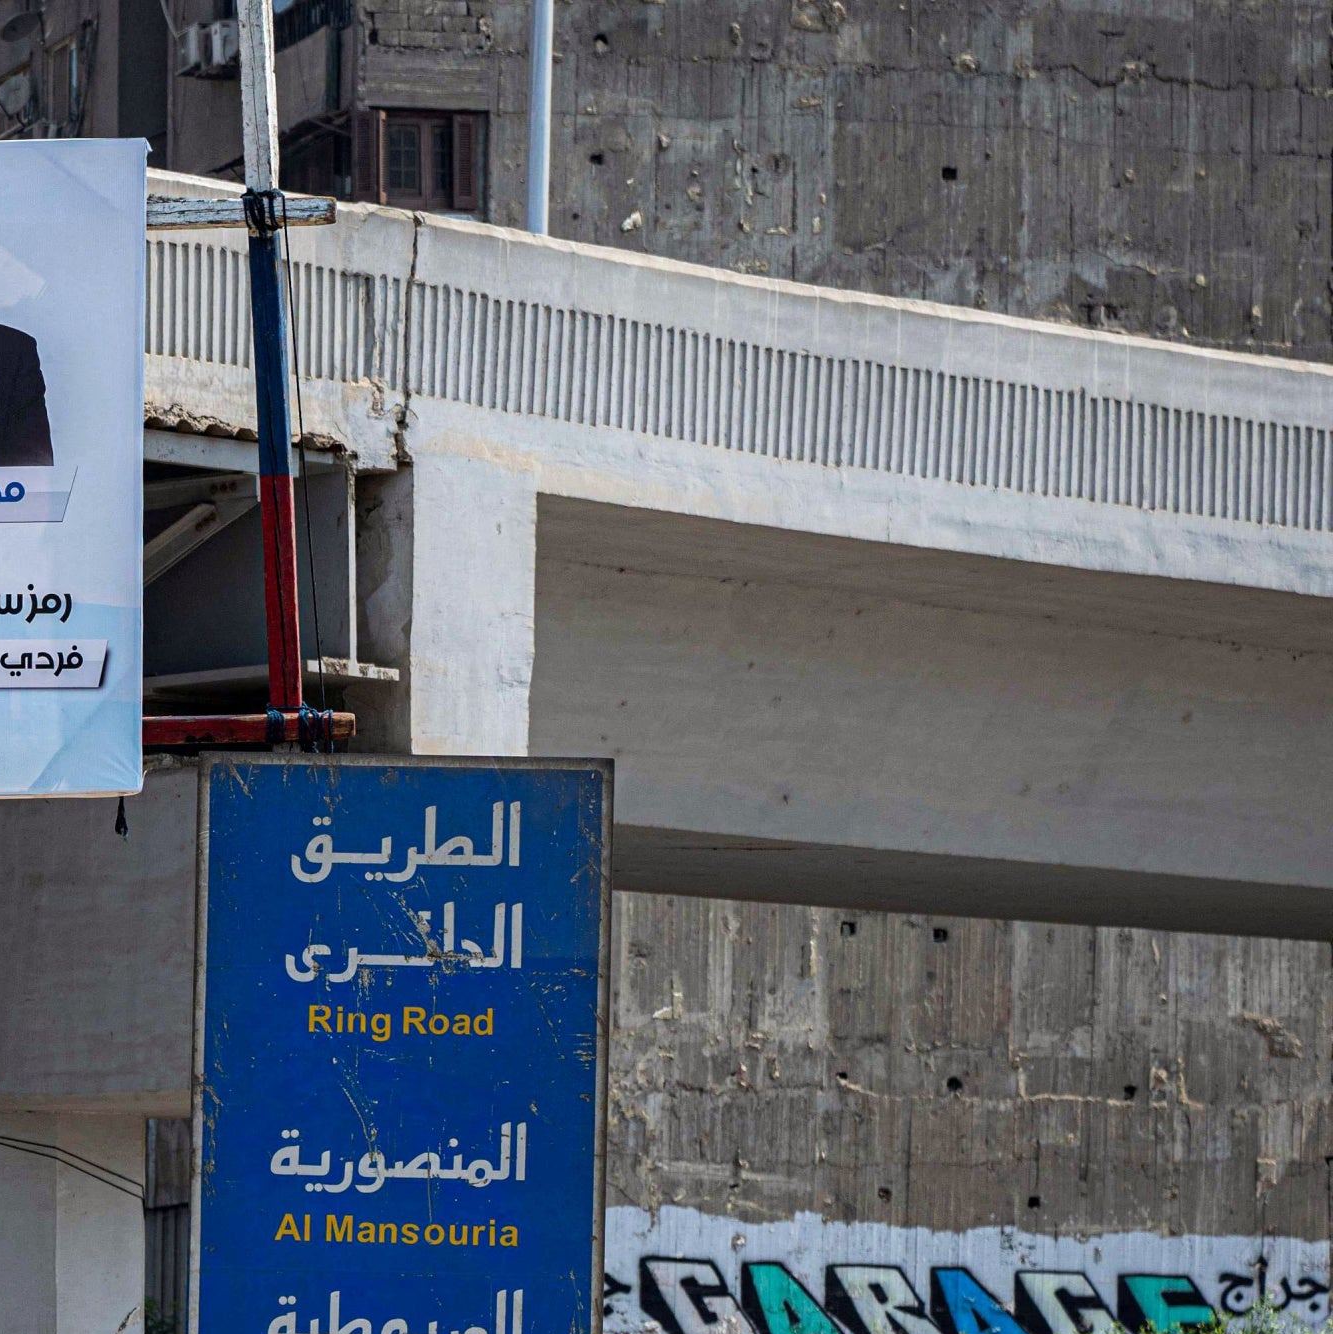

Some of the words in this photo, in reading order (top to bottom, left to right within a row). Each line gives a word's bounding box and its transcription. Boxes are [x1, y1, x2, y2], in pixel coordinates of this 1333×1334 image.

[0, 645, 84, 677] فردي
[292, 801, 520, 882] الطريق
[309, 1005, 391, 1042] Ring
[403, 1007, 493, 1035] Road
[269, 1122, 528, 1194] المنصورية
[275, 1213, 310, 1241] Al
[326, 1215, 517, 1246] Mansouria
